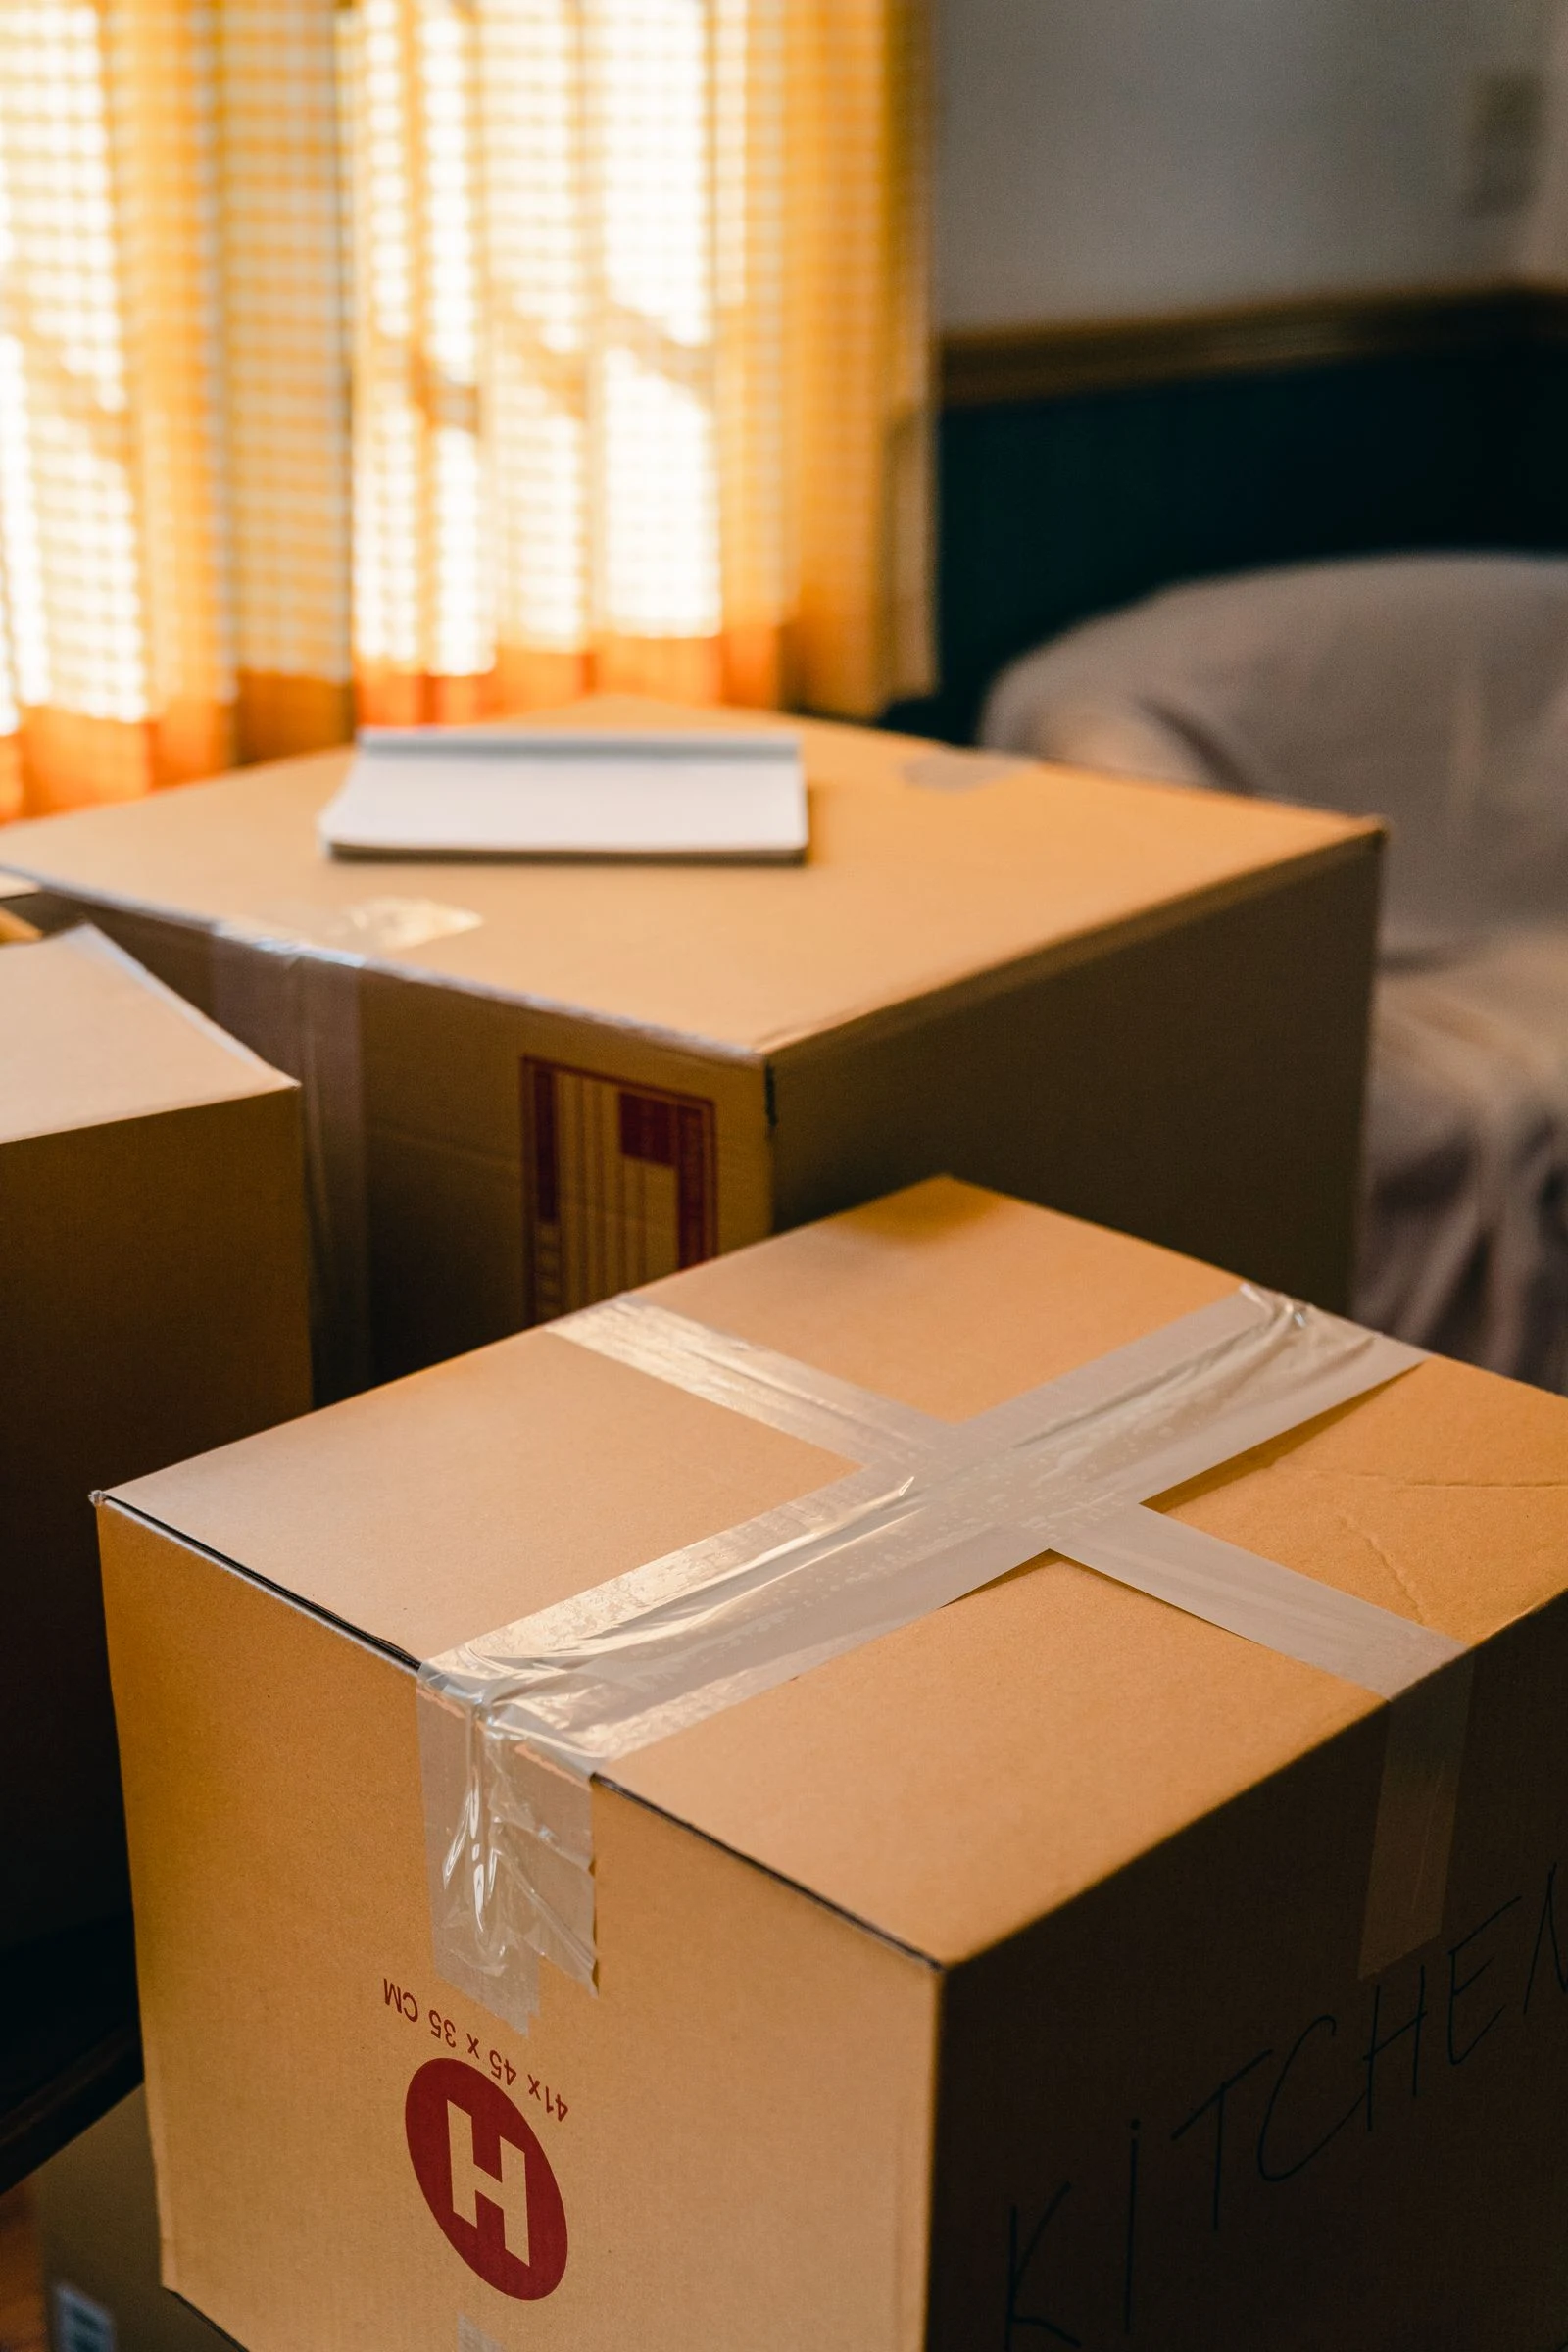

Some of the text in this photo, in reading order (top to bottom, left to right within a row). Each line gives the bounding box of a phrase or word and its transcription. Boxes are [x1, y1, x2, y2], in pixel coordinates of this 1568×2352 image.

[383, 1978, 418, 2022] CM
[428, 2009, 457, 2048] 35
[489, 2049, 517, 2085] 45
[446, 2098, 530, 2268] H
